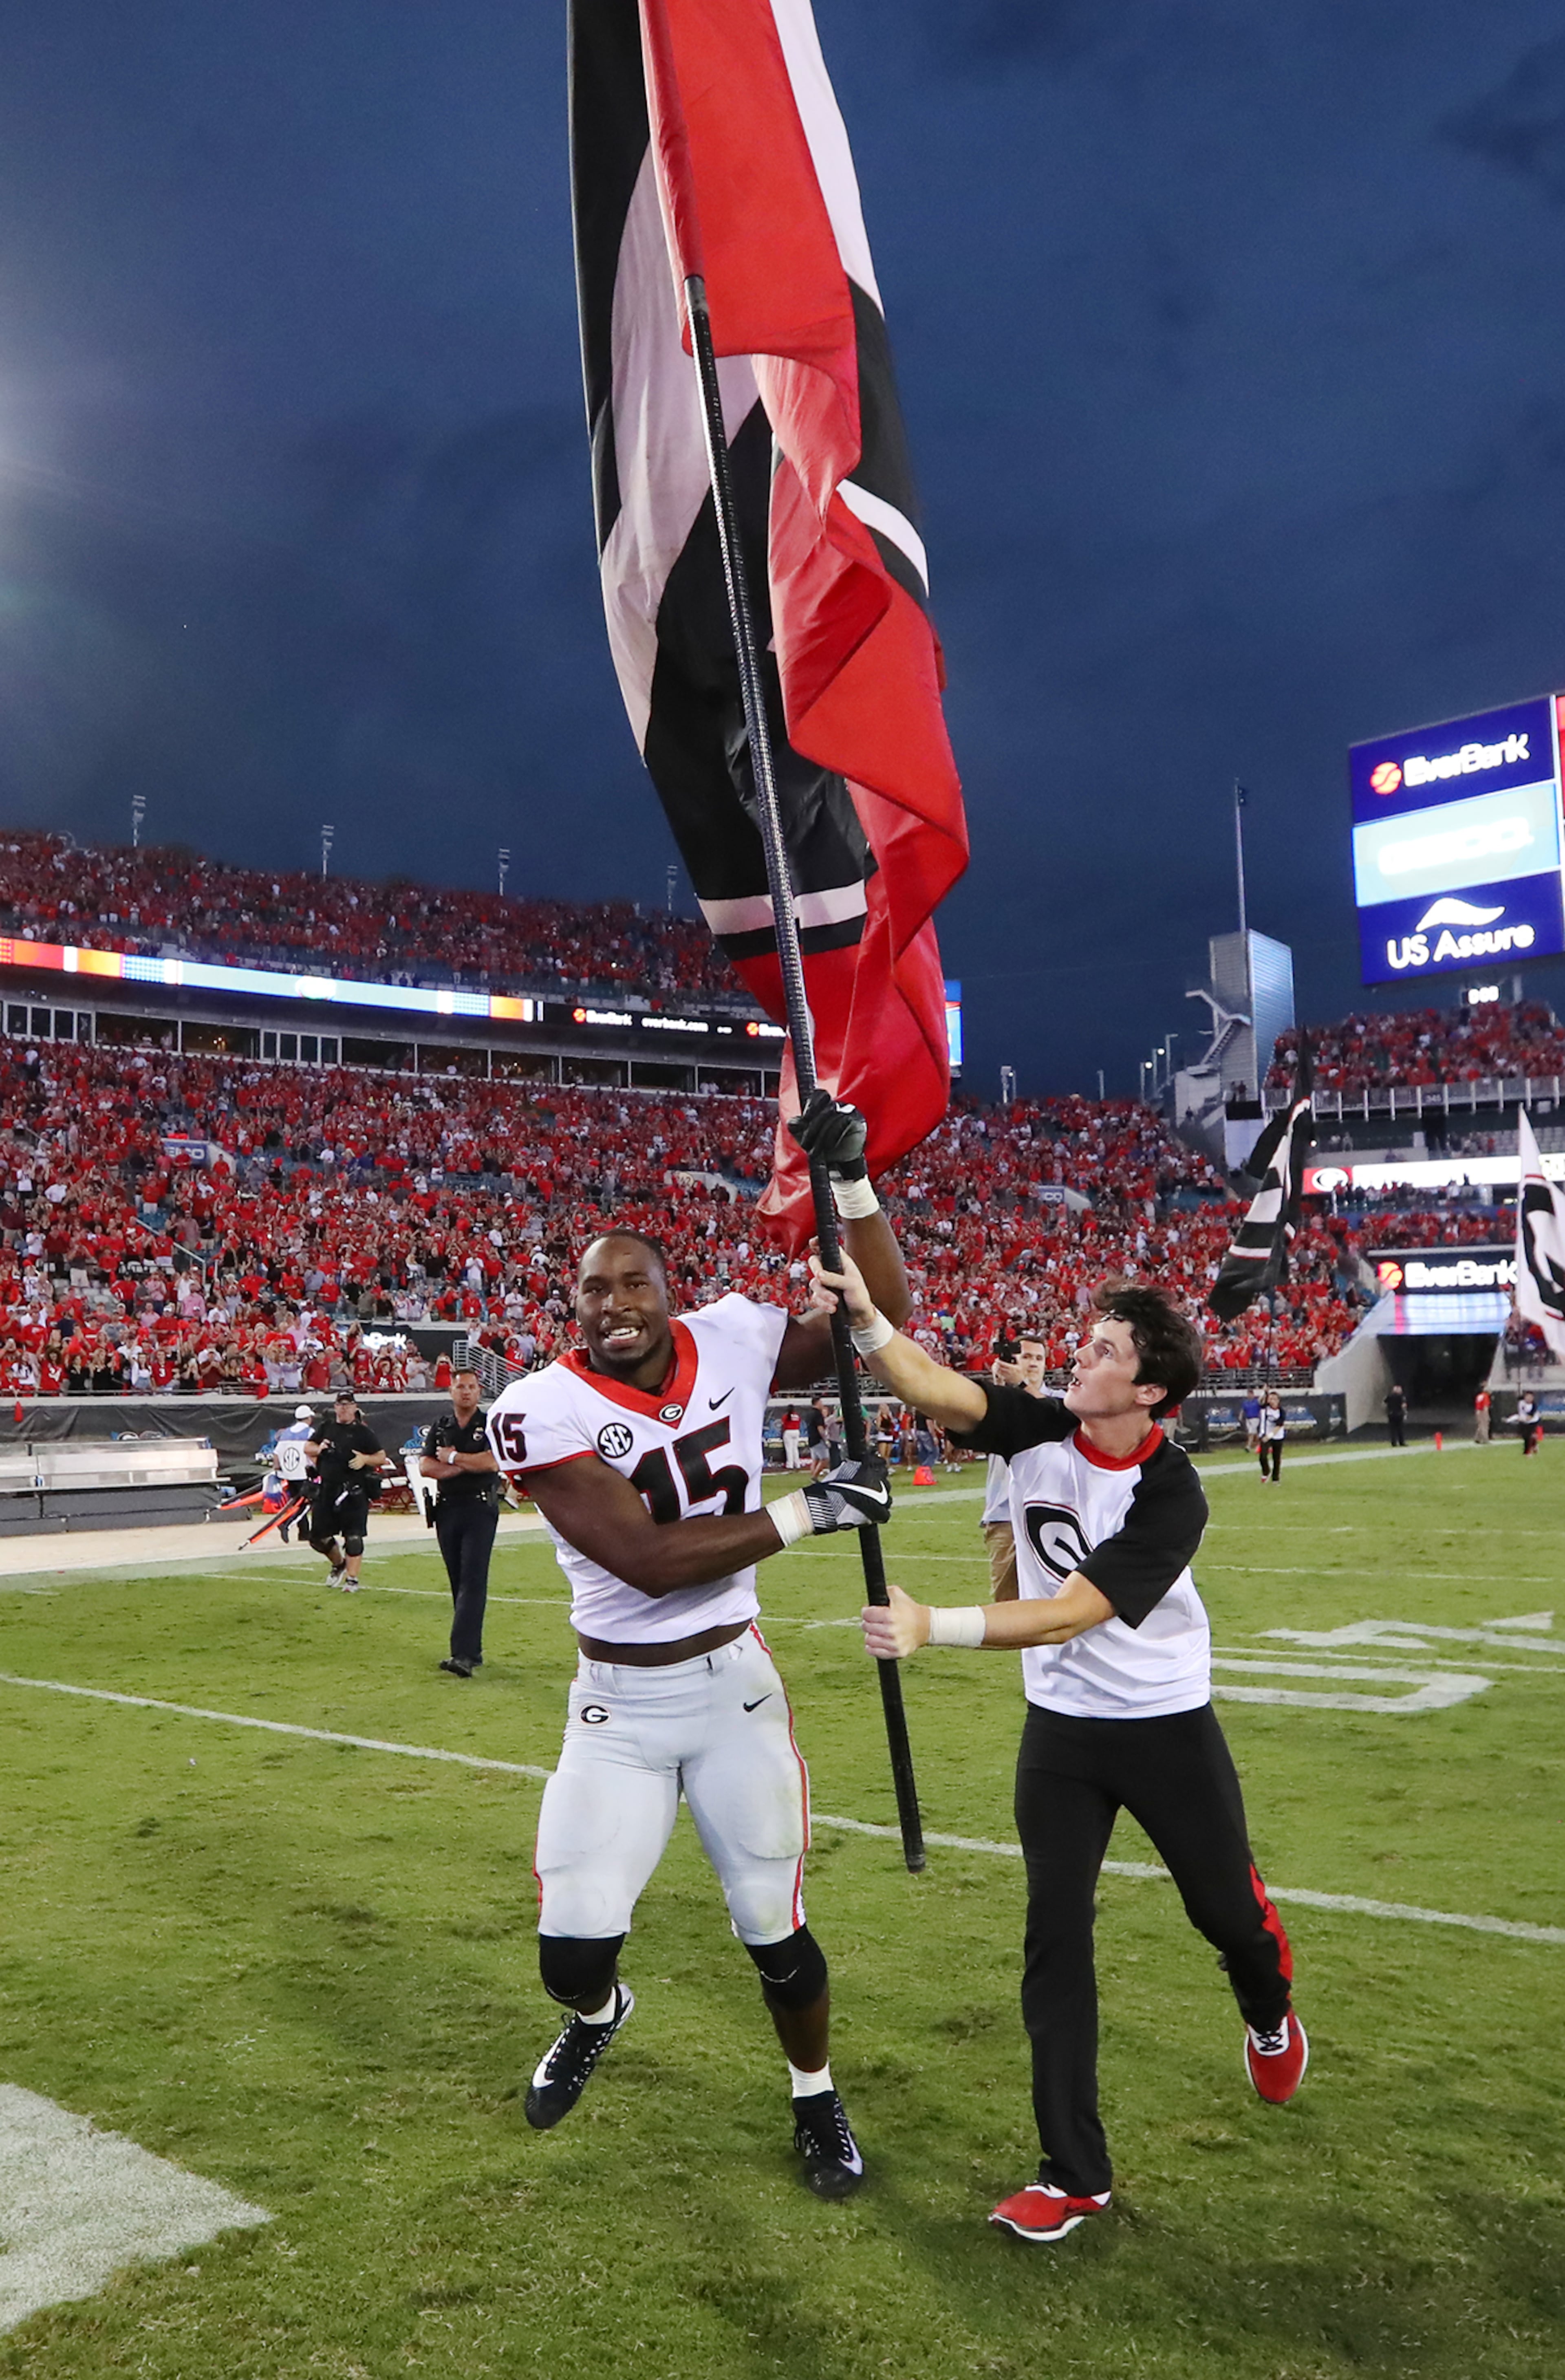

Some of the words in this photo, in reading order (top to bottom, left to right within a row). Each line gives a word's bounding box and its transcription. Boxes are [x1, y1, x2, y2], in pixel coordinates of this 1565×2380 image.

[1387, 934, 1431, 969] US
[1433, 924, 1535, 962] Assure
[490, 1413, 527, 1462] 15
[600, 1424, 633, 1458] SEC
[628, 1416, 749, 1524] 15
[580, 1705, 609, 1724] G
